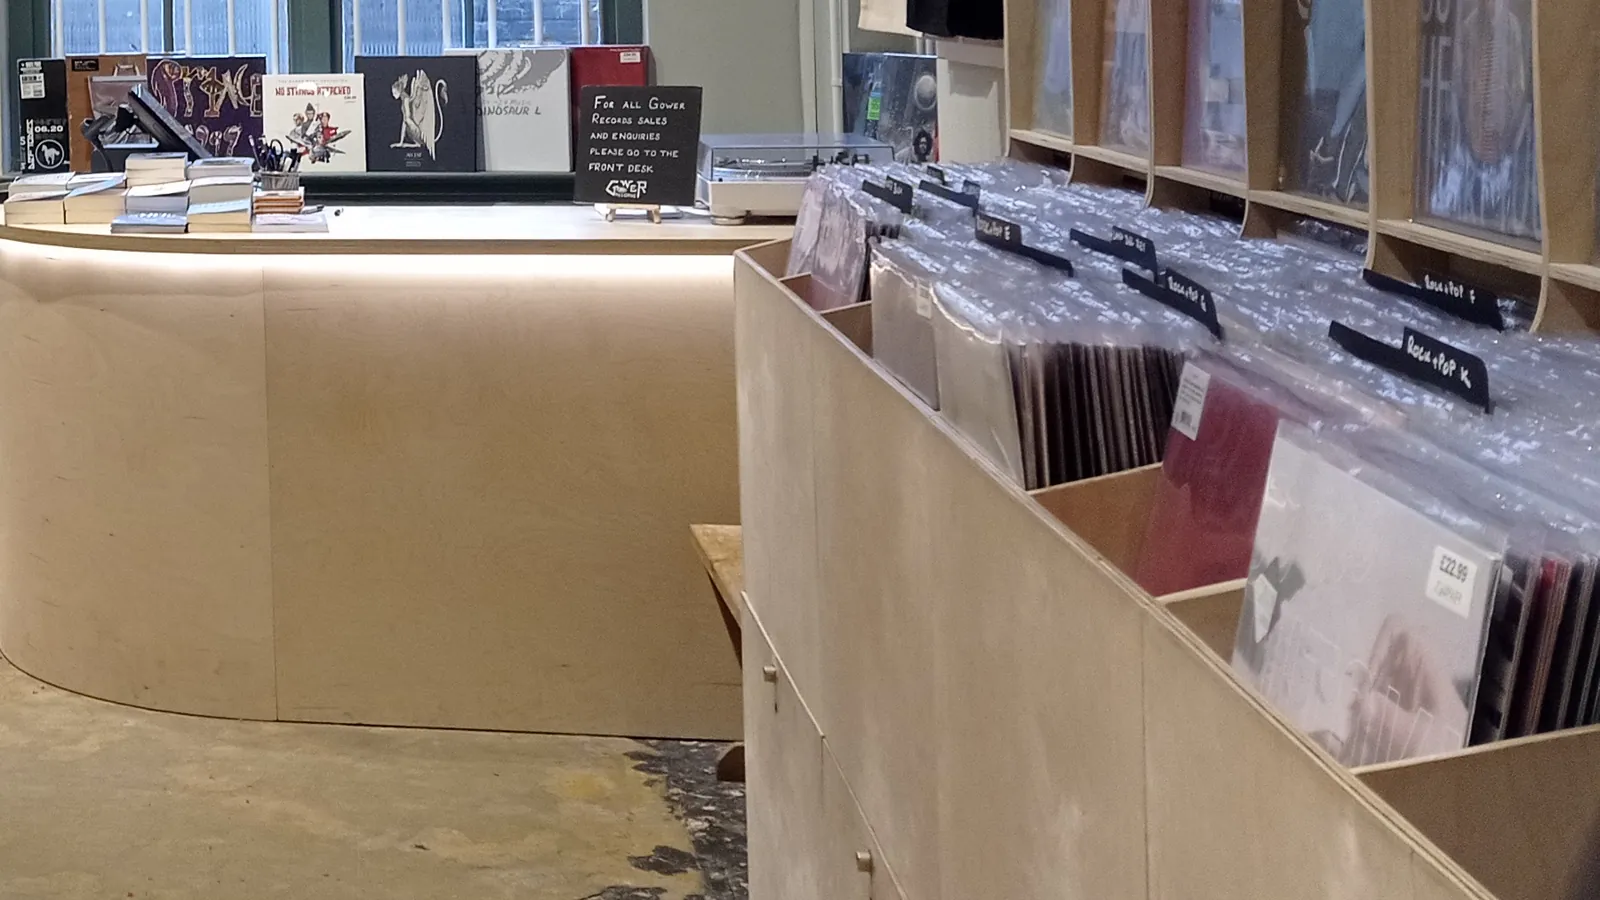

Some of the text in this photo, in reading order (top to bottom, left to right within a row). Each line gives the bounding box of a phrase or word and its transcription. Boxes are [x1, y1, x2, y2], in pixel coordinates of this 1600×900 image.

[594, 95, 686, 110] FOR ALL GOWER
[591, 112, 668, 126] RECORDS SALES
[590, 132, 661, 141] AND ENQUIRIES
[589, 147, 679, 158] PLEASE GO TO THE
[588, 162, 654, 173] FRONT DESK
[1460, 365, 1472, 389] K
[1440, 554, 1468, 584] £22.99
